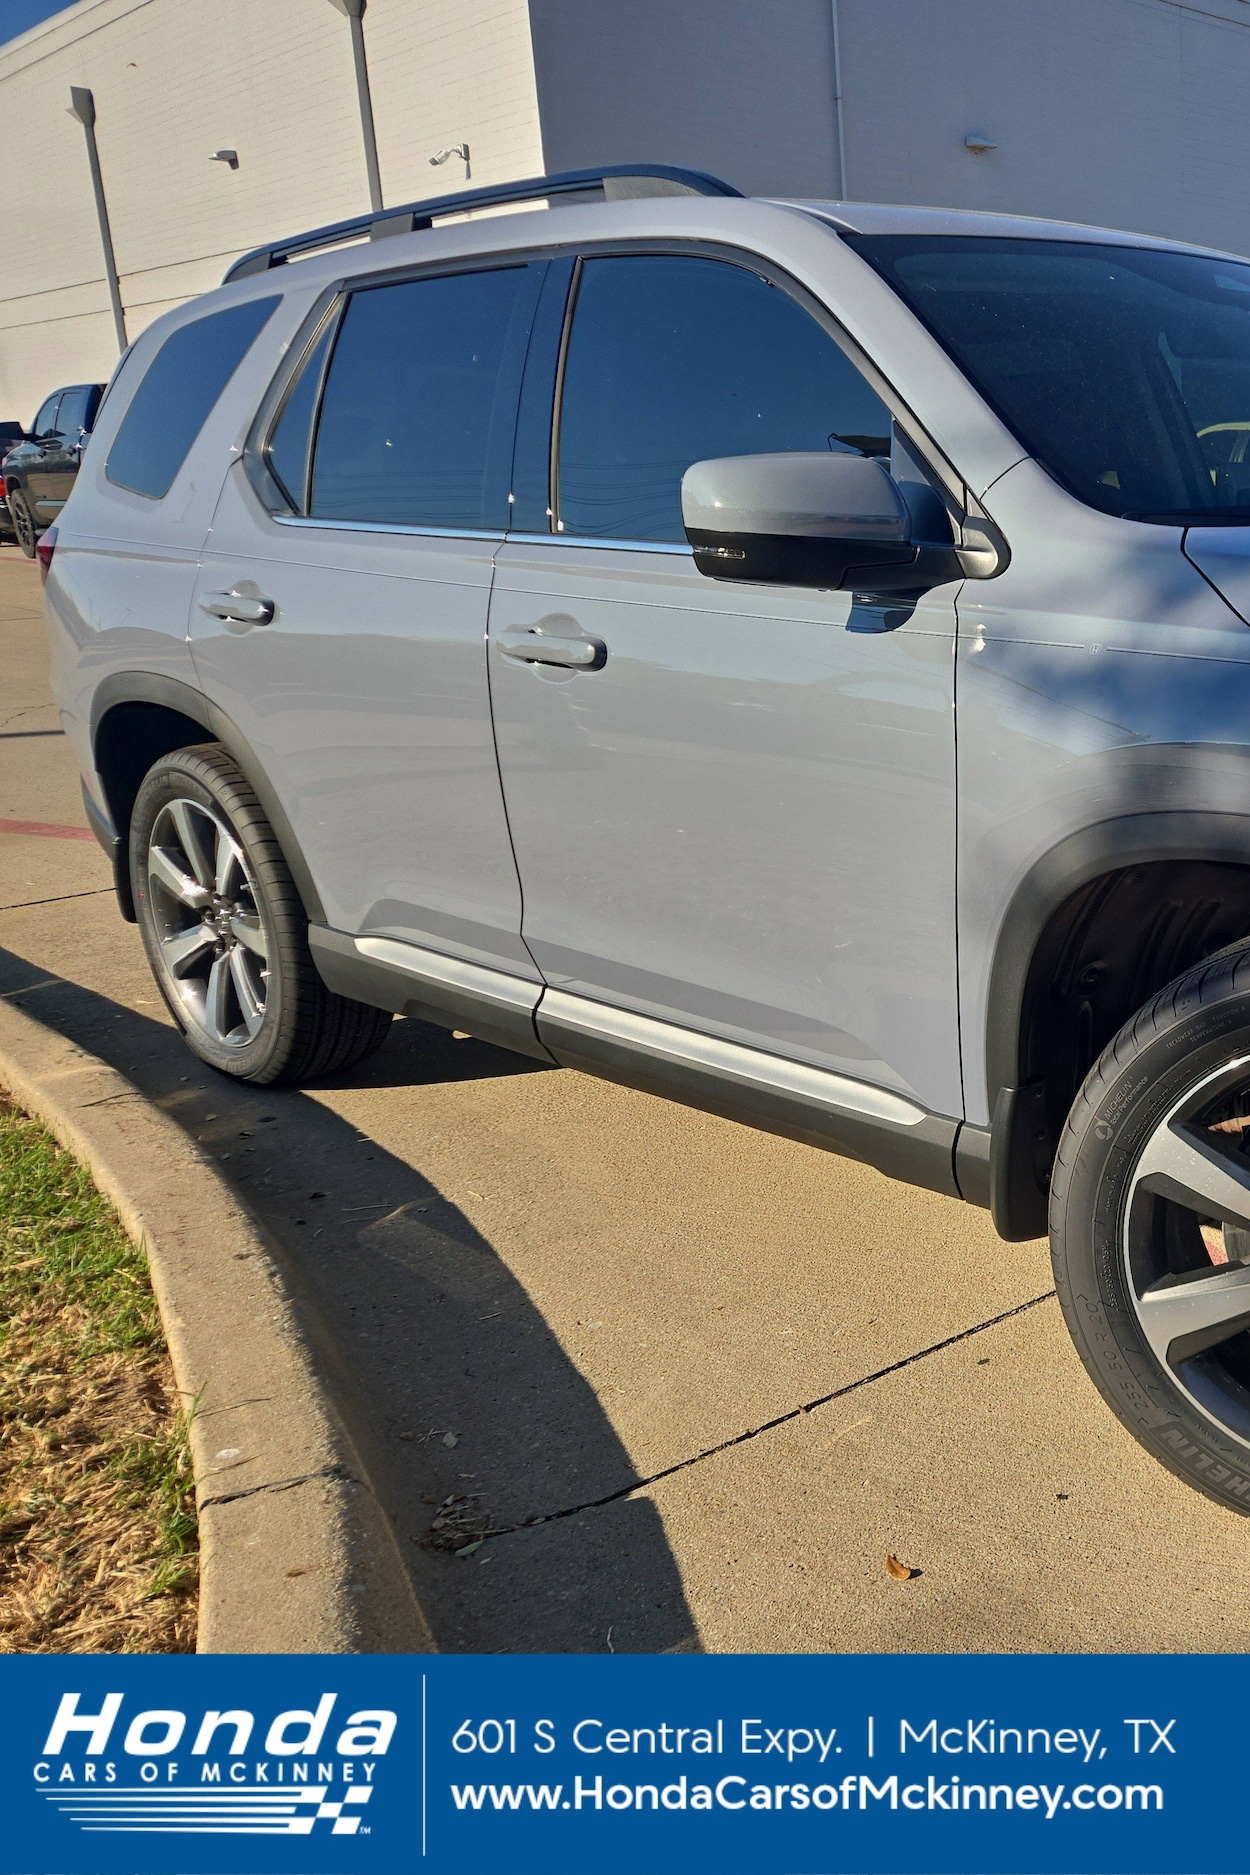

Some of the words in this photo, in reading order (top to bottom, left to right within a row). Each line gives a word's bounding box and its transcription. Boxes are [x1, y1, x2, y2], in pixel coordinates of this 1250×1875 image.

[1104, 1080, 1132, 1120] MICHELIN
[1110, 1109, 1122, 1125] Total
[1118, 1076, 1148, 1113] Performance
